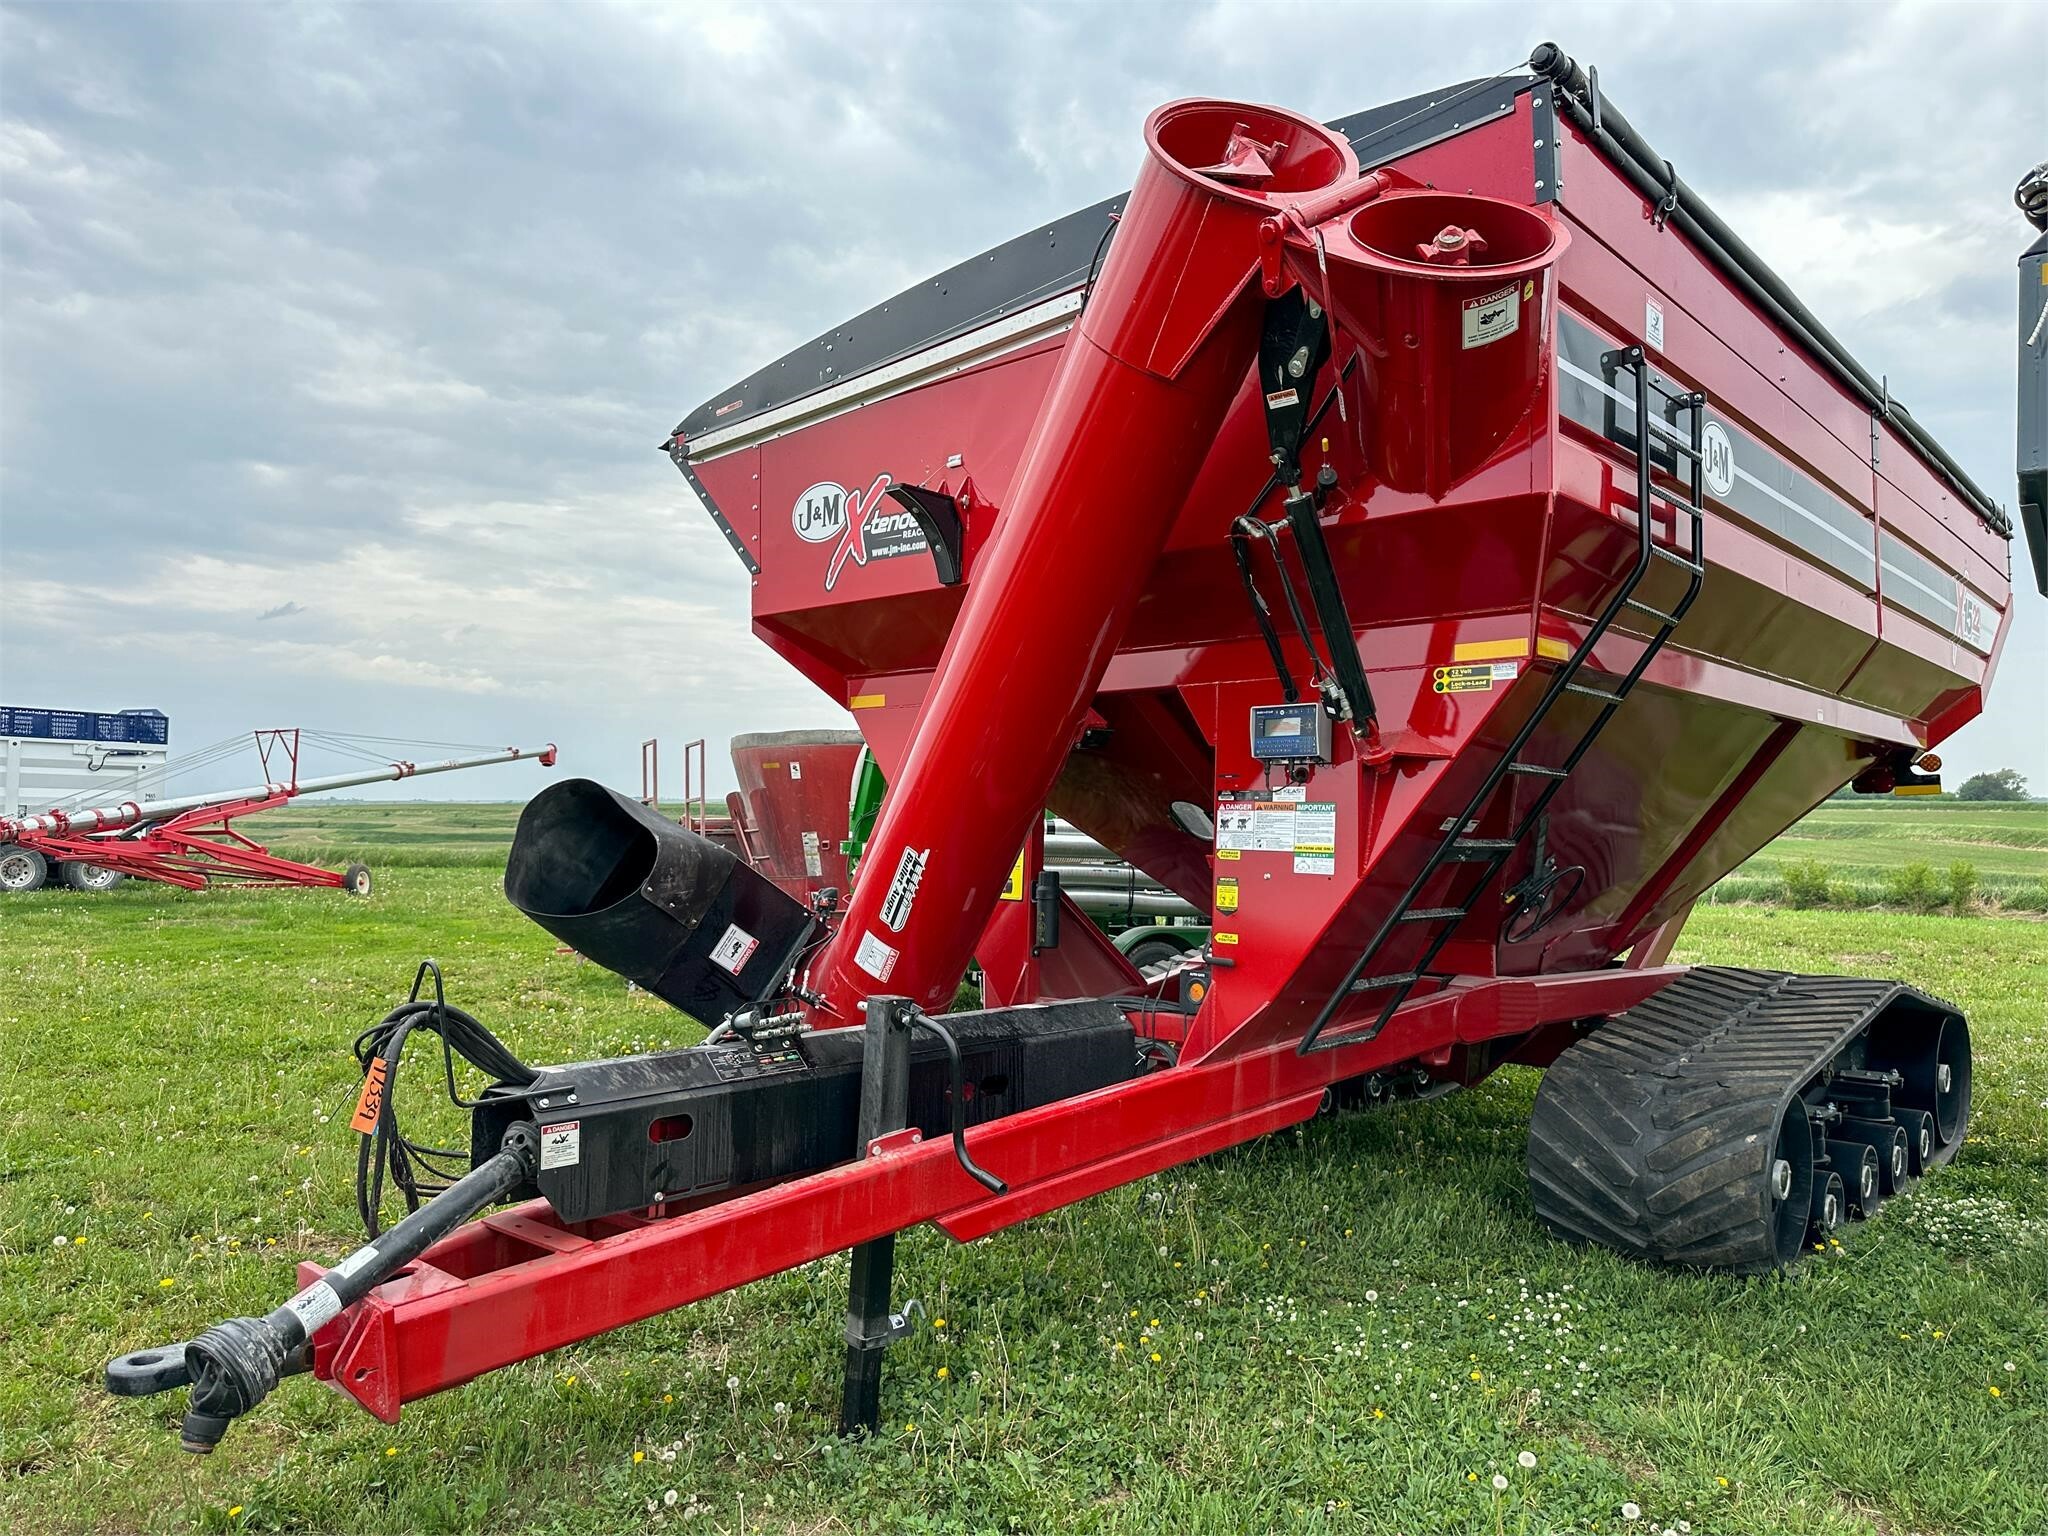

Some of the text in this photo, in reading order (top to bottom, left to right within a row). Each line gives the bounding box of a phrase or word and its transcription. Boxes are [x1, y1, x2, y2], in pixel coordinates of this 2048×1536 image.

[1480, 286, 1515, 305] DANGER
[1704, 435, 1729, 484] J&M
[798, 493, 840, 532] J&M
[903, 527, 924, 538] REAC
[872, 541, 926, 557] www.jm-inc.com
[897, 852, 914, 886] Bullet
[885, 886, 900, 919] Auger
[552, 1124, 576, 1133] DANGER
